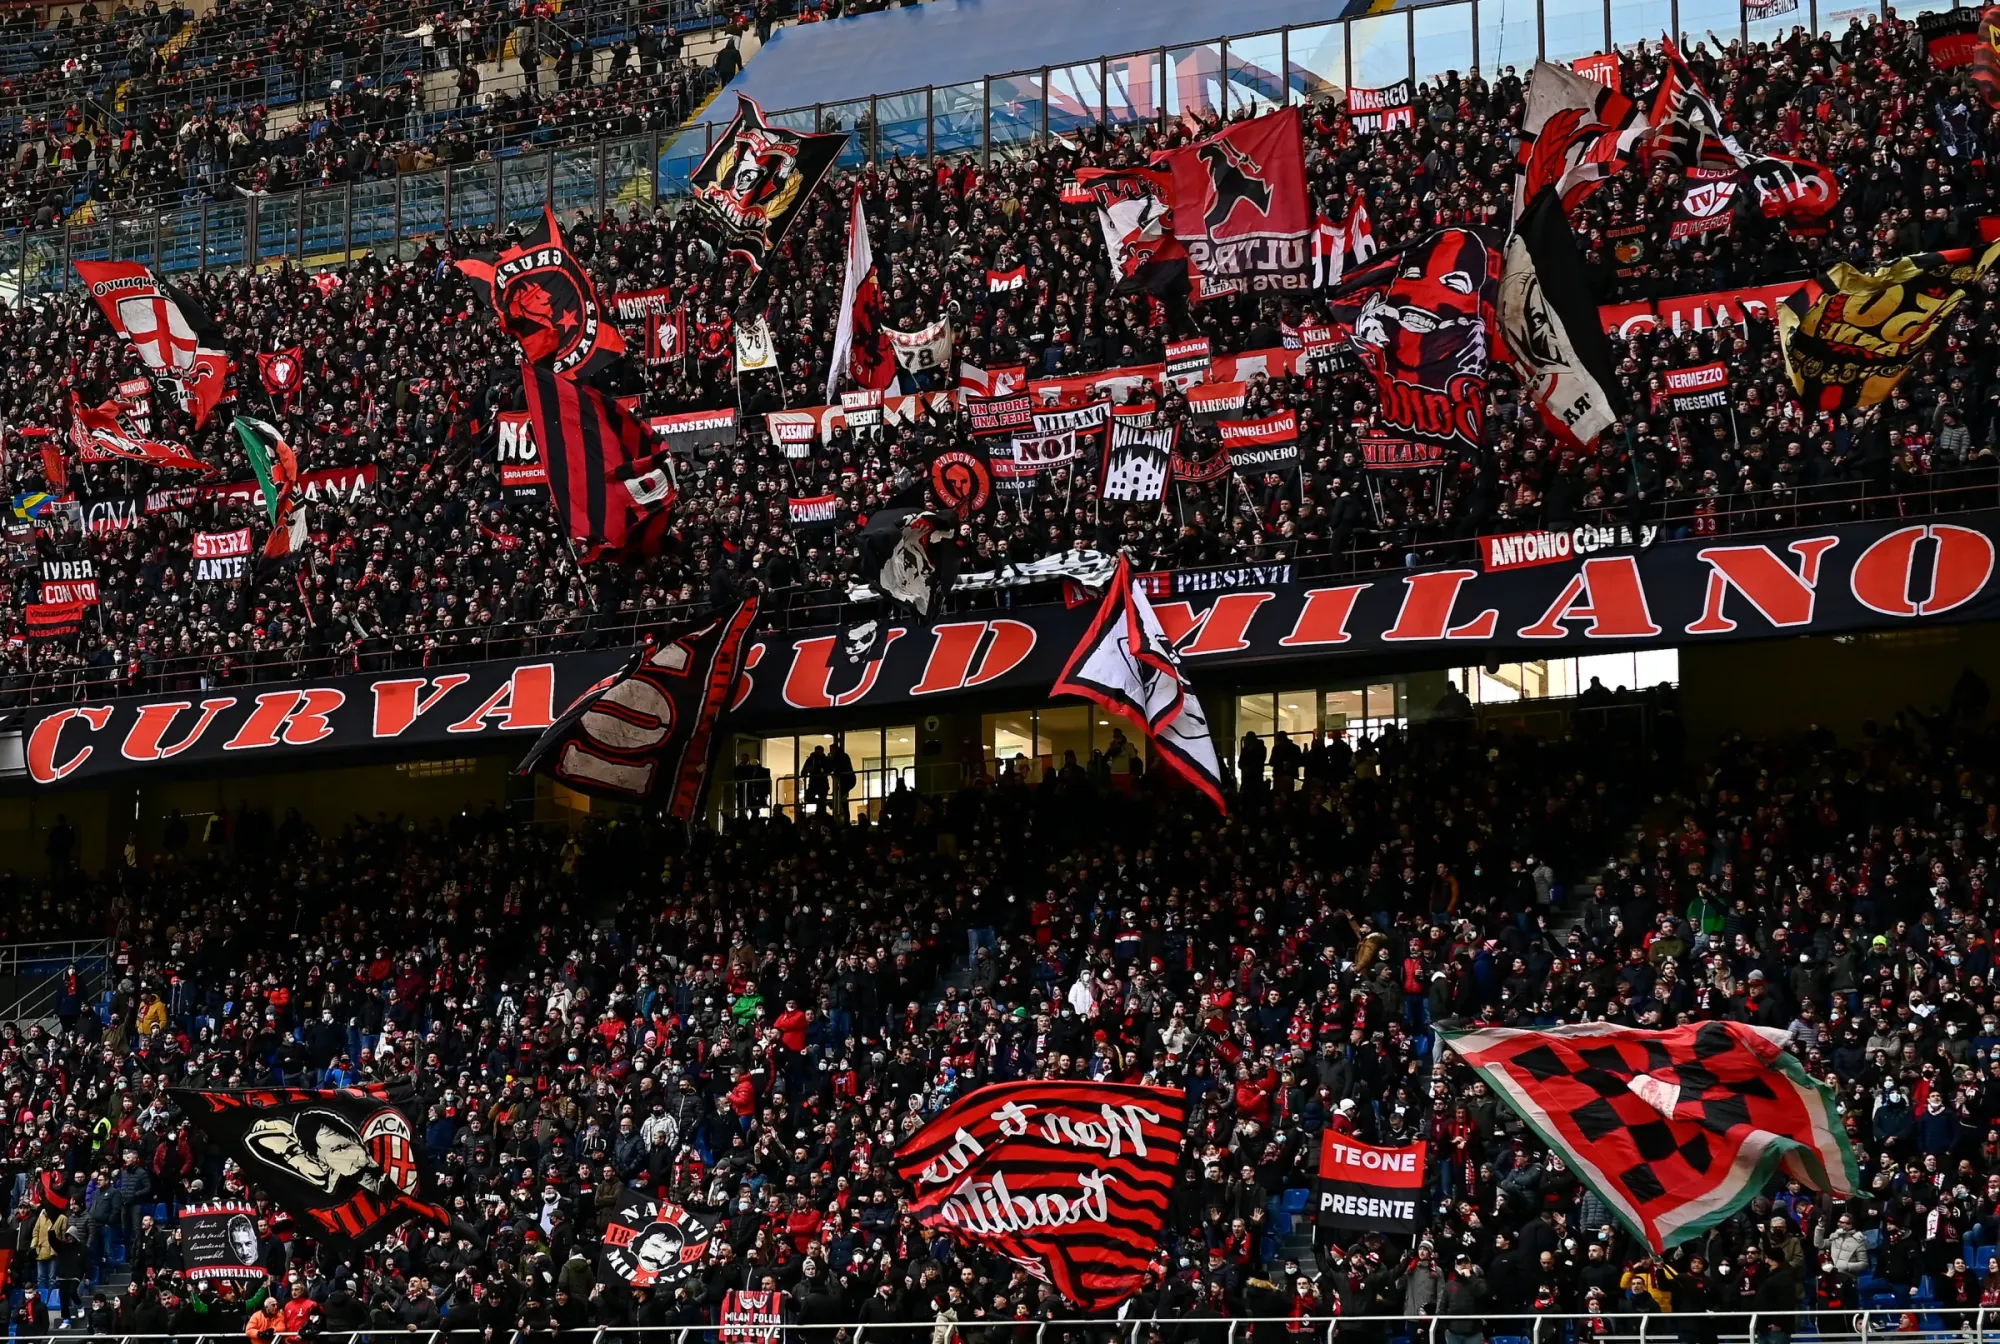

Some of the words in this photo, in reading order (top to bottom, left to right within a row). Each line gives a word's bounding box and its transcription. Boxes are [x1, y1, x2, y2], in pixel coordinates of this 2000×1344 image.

[1350, 83, 1409, 111] MAGICO
[1352, 109, 1411, 136] MILAN
[990, 274, 1023, 293] MB
[1303, 327, 1331, 343] NON
[902, 349, 935, 370] 78
[1166, 342, 1208, 357] BULGARIA
[1167, 357, 1209, 372] PRESENTE
[1667, 367, 1724, 390] VERMEZZO
[969, 403, 987, 416] UN
[989, 397, 1030, 413] CUORE
[1189, 396, 1245, 414] VIAREGGIO
[1673, 391, 1727, 412] PRESENTE
[653, 416, 732, 435] TRANSENNA
[845, 409, 881, 427] PRESENTE
[971, 416, 997, 428] UNA
[1000, 411, 1031, 425] FEDE
[1038, 405, 1107, 431] MILANO
[1221, 418, 1294, 439] GIAMBELLINO
[1020, 435, 1073, 462] NOI
[1112, 422, 1173, 454] MILANO
[935, 452, 976, 468] COLOGNO
[1230, 445, 1298, 467] ROSSONERO
[1362, 440, 1445, 463] MILANO
[521, 487, 537, 497] AMO
[789, 501, 837, 524] SCALMANATI
[197, 529, 248, 555] STERZ
[1491, 531, 1571, 567] ANTONIO
[1572, 525, 1616, 554] CON
[43, 559, 93, 581] IVREA
[1177, 563, 1291, 593] PRESENTI
[45, 584, 74, 605] CON
[75, 583, 97, 601] VOI
[27, 662, 557, 785] CURVA
[1151, 522, 1997, 657] MILANO
[371, 1117, 409, 1135] ACM
[1332, 1143, 1417, 1172] TEONE
[186, 1200, 252, 1215] MANOLO
[1320, 1192, 1416, 1220] PRESENTE
[620, 1201, 709, 1242] NATIVI
[612, 1226, 628, 1244] 18
[684, 1244, 702, 1261] 99
[191, 1267, 264, 1281] GIAMBELLINO
[606, 1248, 693, 1285] MILANO
[725, 1312, 750, 1323] MILAN
[753, 1312, 781, 1324] FOLLIA
